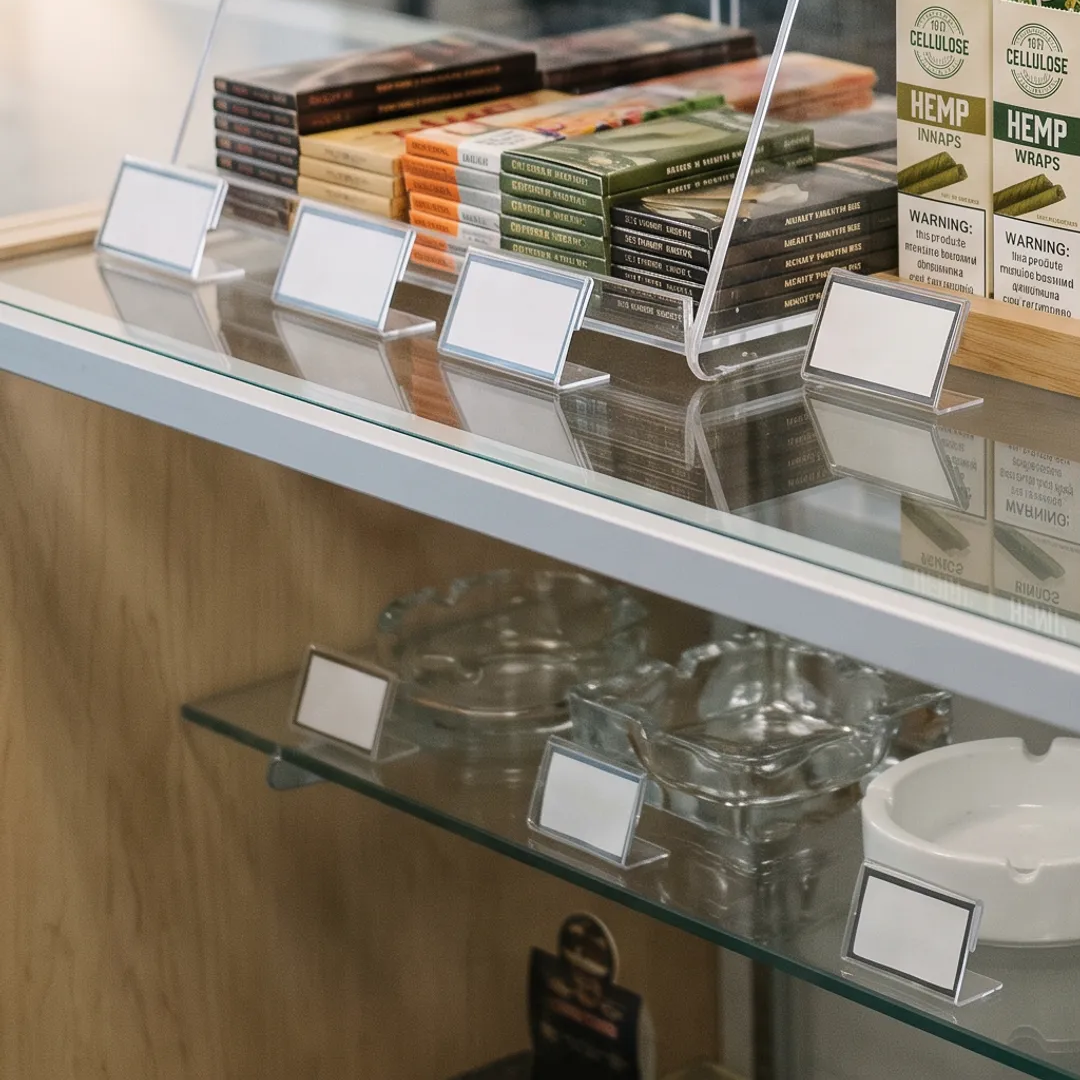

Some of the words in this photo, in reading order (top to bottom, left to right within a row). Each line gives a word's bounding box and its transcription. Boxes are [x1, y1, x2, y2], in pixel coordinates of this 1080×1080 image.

[910, 29, 969, 56] CELLULOSE
[1006, 48, 1068, 75] CELLULOSE
[911, 89, 969, 127] HEMP
[1008, 109, 1068, 148] HEMP
[1015, 148, 1060, 171] WRAPS
[909, 208, 973, 235] WARNING:
[1005, 230, 1070, 257] WARNING:
